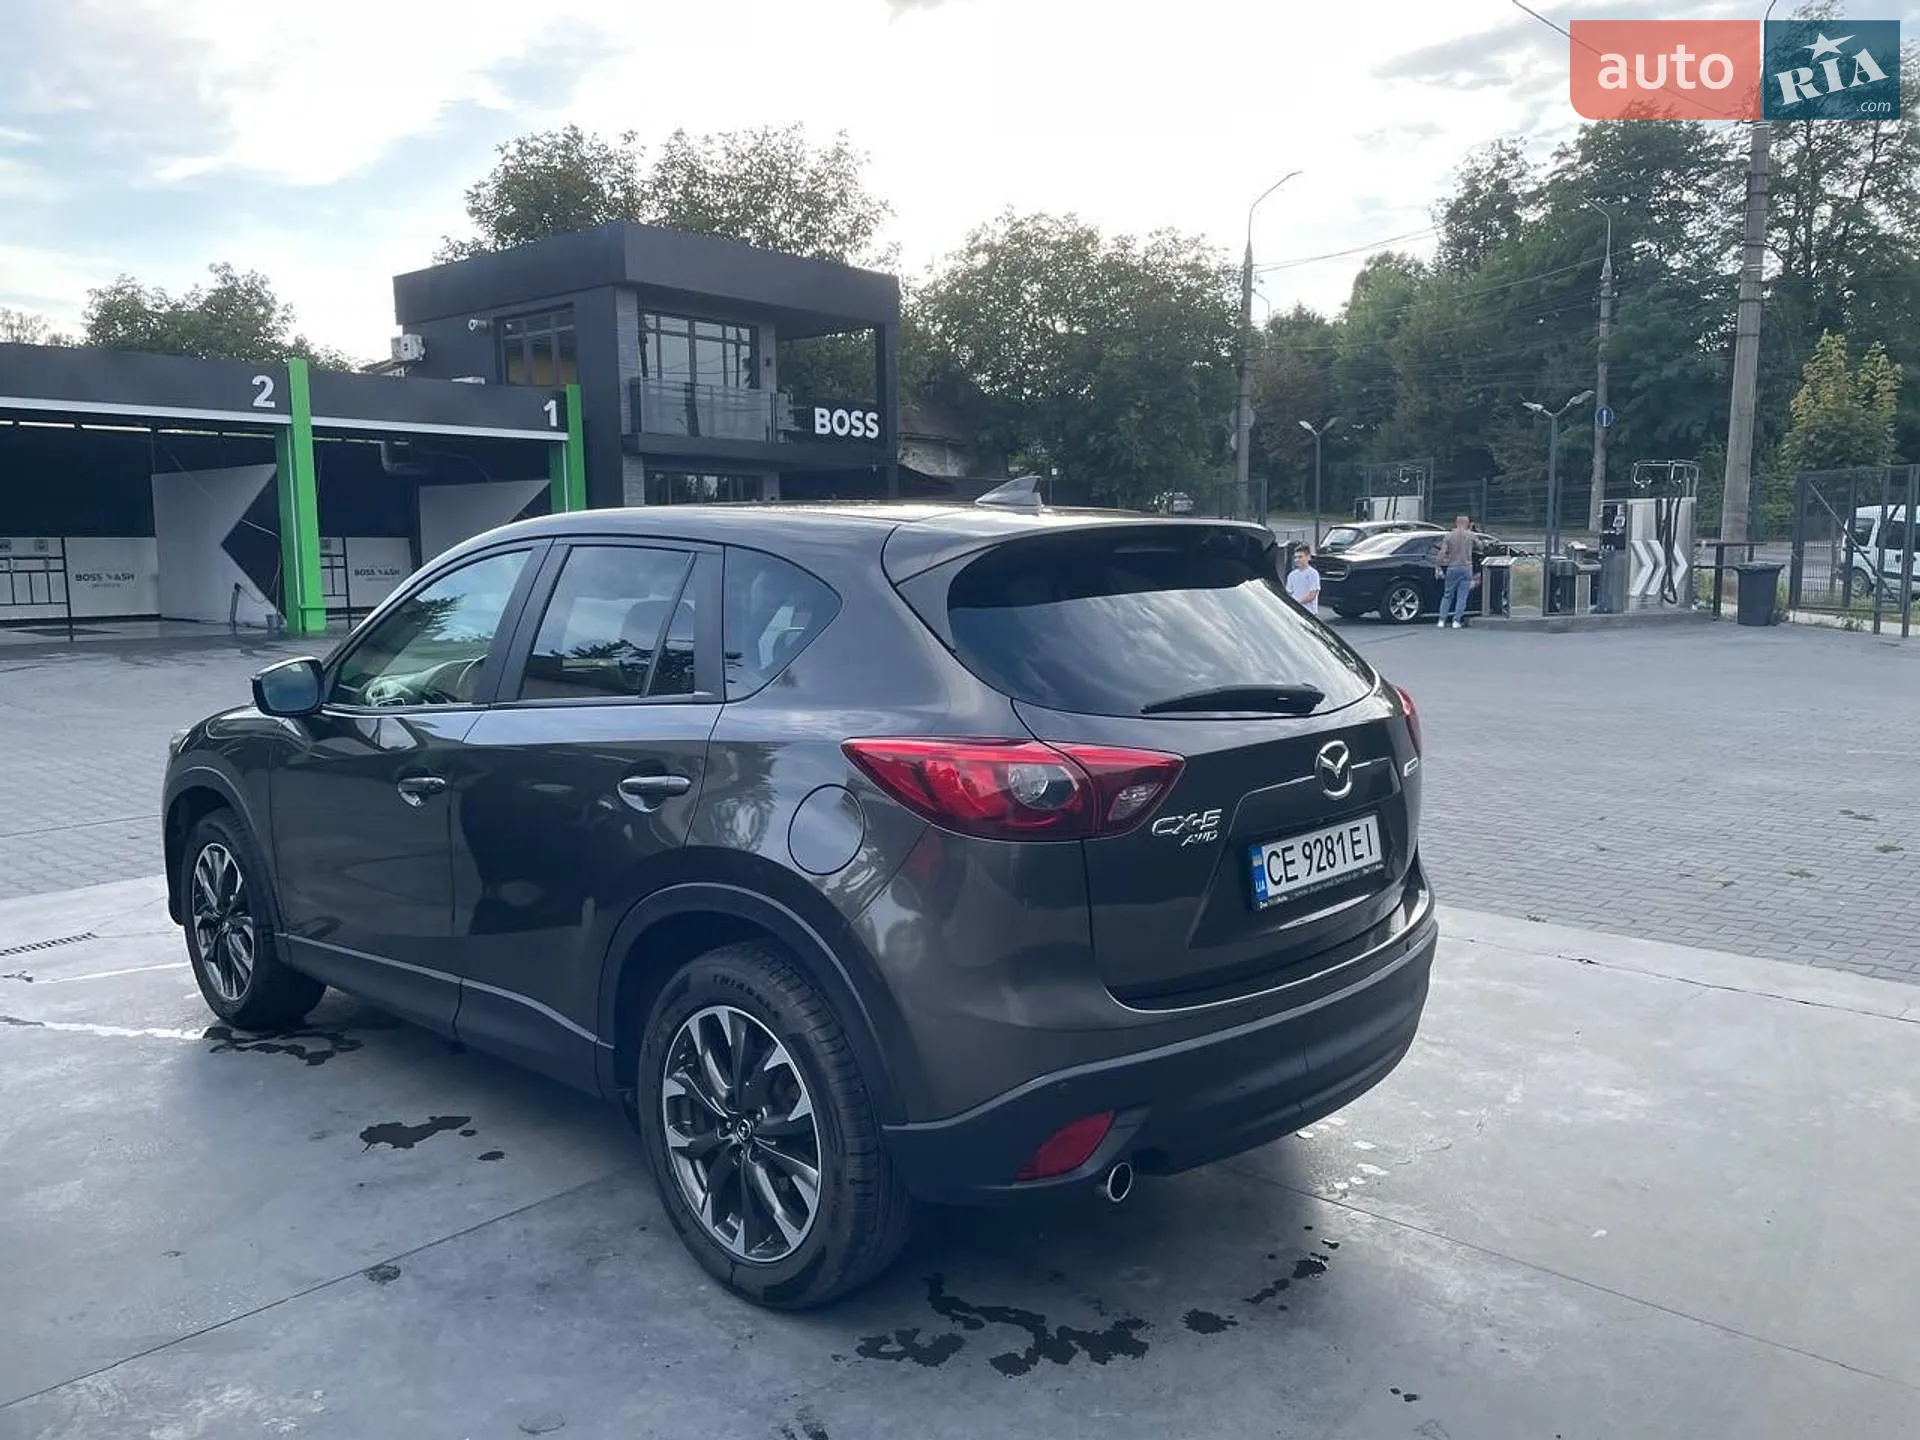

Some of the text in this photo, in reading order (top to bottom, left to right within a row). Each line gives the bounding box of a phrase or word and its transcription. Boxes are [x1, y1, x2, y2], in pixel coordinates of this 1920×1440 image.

[252, 375, 275, 408] 2
[544, 399, 557, 427] 1
[814, 407, 879, 439] BOSS
[75, 573, 102, 582] BOSS
[1267, 845, 1298, 886] CE
[1302, 831, 1347, 877] 9281
[1349, 823, 1373, 861] EI
[1255, 879, 1266, 893] UA
